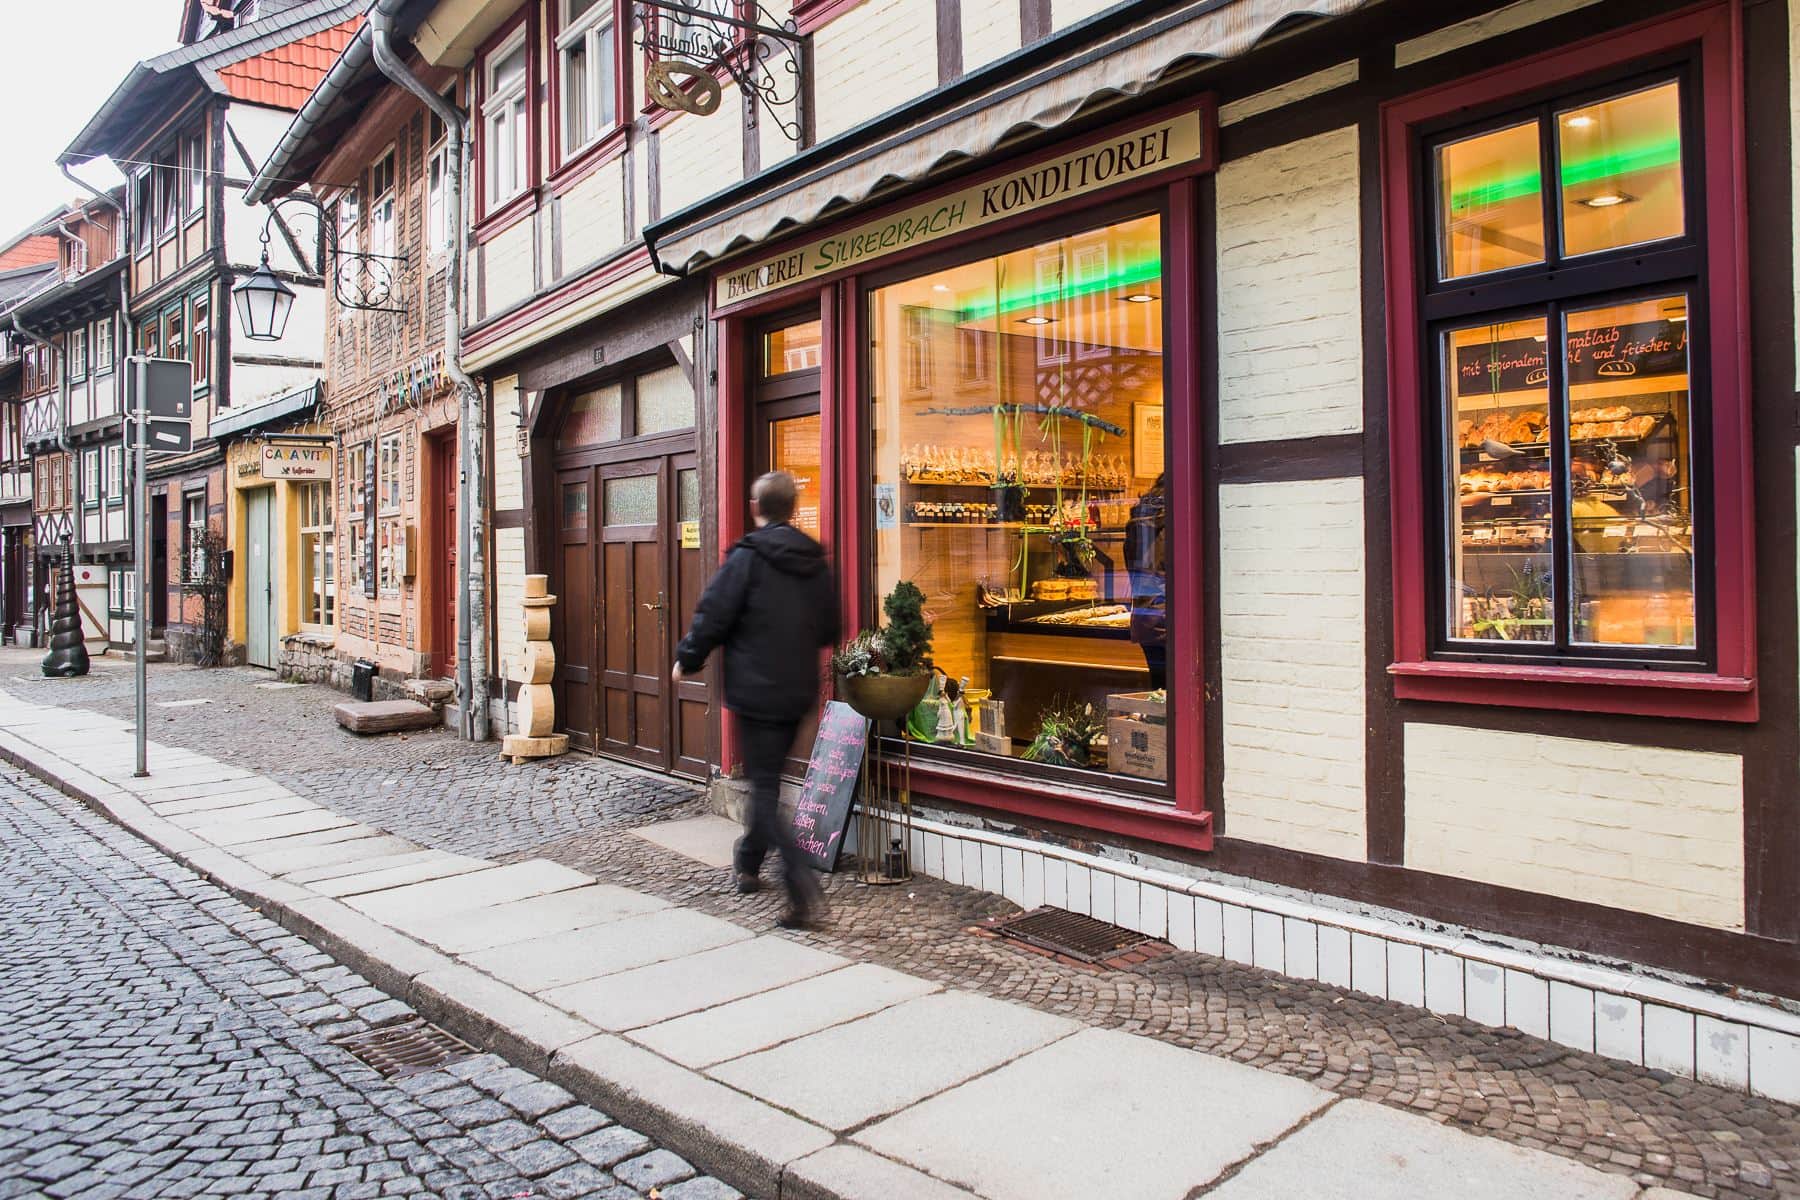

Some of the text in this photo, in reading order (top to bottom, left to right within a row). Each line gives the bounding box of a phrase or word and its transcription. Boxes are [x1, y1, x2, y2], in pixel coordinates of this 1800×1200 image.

[726, 252, 805, 299] BÄCKEREI
[980, 126, 1172, 218] KONDITOREI
[1461, 359, 1480, 377] mit
[1592, 344, 1615, 360] und
[1621, 336, 1671, 362] frischer
[265, 448, 330, 461] CASA VITA
